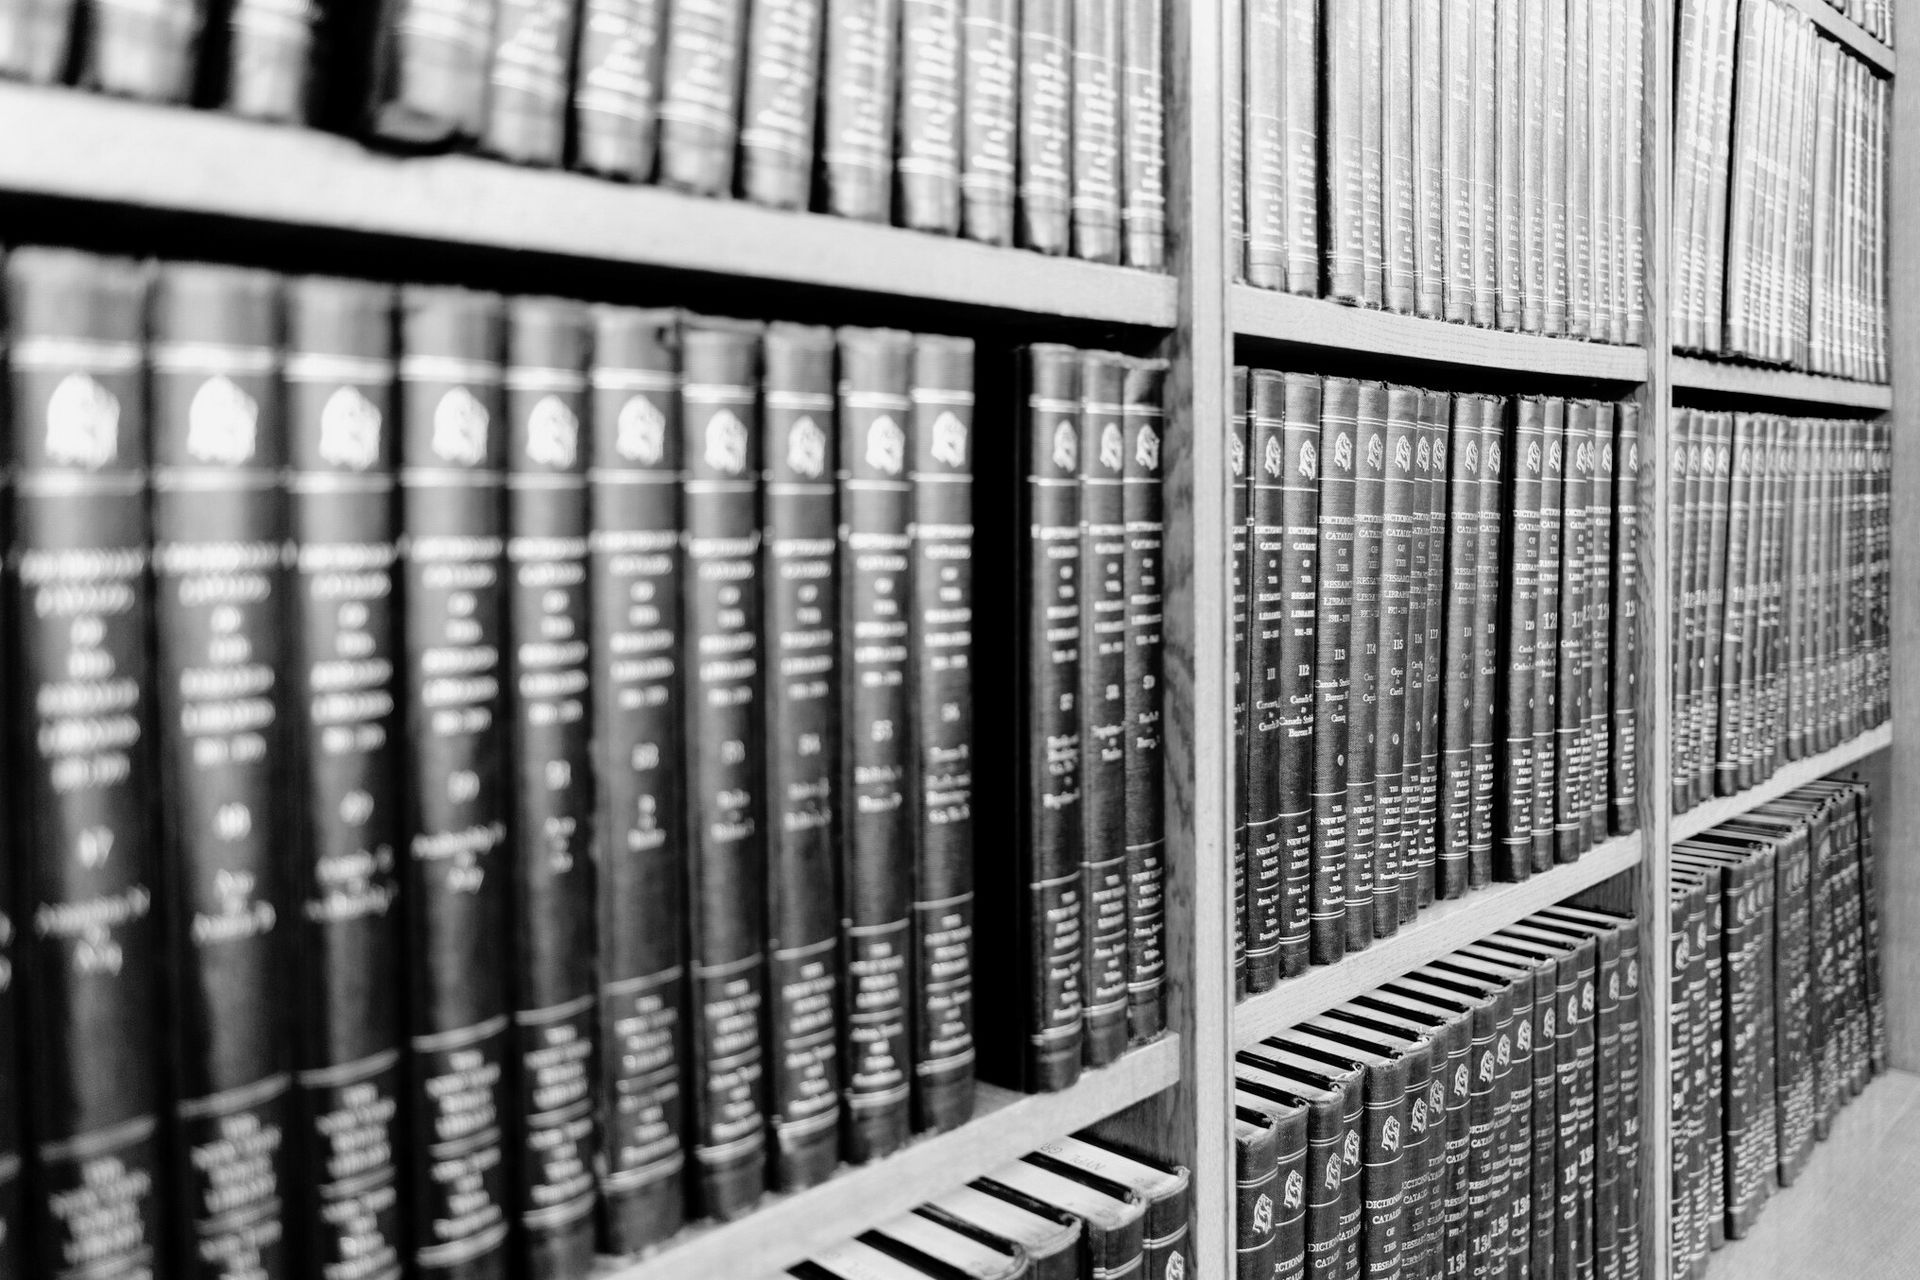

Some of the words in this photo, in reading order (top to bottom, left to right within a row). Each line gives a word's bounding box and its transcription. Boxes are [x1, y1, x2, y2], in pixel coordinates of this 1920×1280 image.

[1366, 644, 1377, 655] 114
[1393, 639, 1404, 650] 115
[1334, 649, 1346, 661] 113
[1298, 664, 1310, 676] 112
[1386, 1226, 1396, 1237] OF
[1384, 1241, 1397, 1254] THE
